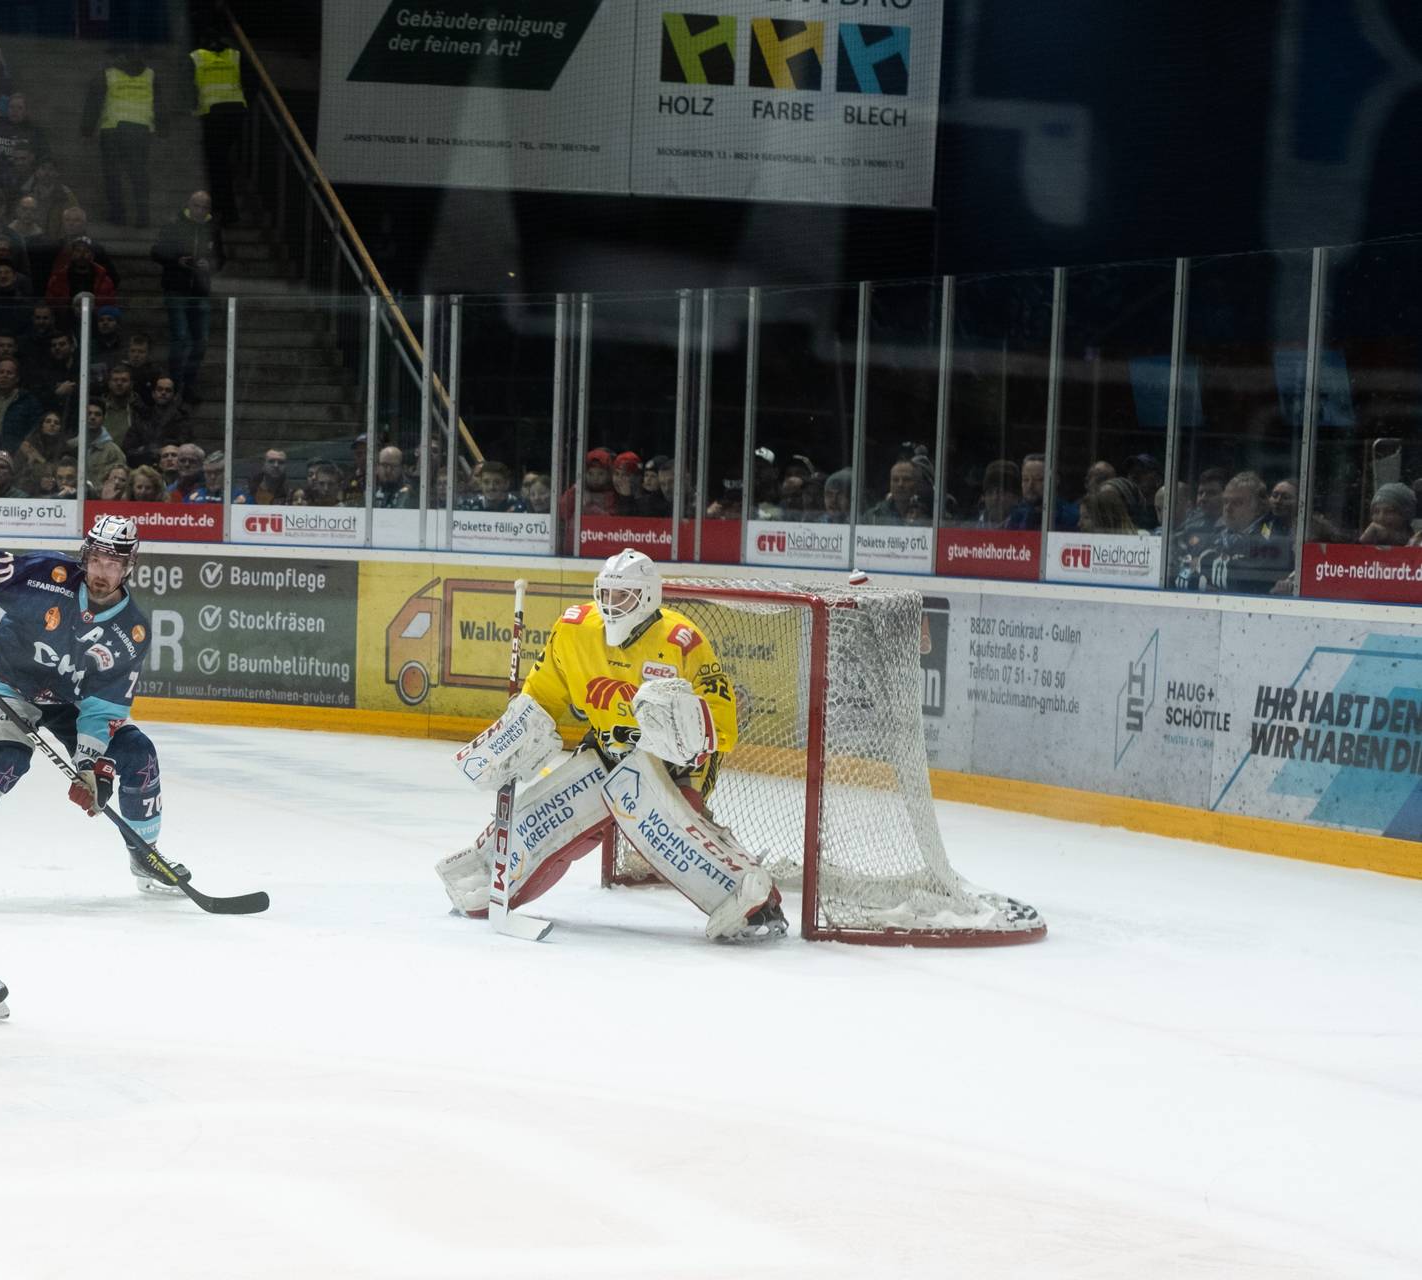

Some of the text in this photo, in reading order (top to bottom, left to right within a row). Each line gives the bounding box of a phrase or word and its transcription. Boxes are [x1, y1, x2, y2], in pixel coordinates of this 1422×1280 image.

[395, 8, 568, 40] Gebäudereinigung
[387, 33, 521, 57] der feinen Art!
[658, 95, 907, 127] HOLZ FARBE BLECH
[36, 504, 67, 518] GTÜ.
[245, 514, 357, 533] GTÜ Neidhardt
[453, 520, 550, 537] Plakette fällig? GTÜ.
[580, 529, 673, 546] gtue-neidhardt.de
[757, 531, 843, 553] GTÜ Neidhardt
[856, 535, 928, 553] Plakette fällig? GTÜ.
[947, 543, 1032, 563] gtue-neidhardt.de
[1061, 544, 1151, 569] GTÜ Neidhardt
[229, 565, 326, 592] Baumpflege
[77, 625, 105, 643] A
[228, 609, 326, 634] Stockfräsen
[459, 620, 512, 643] Walko
[970, 616, 1082, 644] 88287 Grünkraut Gullen
[969, 639, 1039, 663] Kaufstraße 6 8
[227, 652, 350, 684] Baumbelüftung
[968, 661, 1066, 689] Telefon 07 51 7 60 50
[966, 686, 1080, 715] www.buchmann-gmbh.de
[1253, 685, 1422, 736] IHR HABT DEN
[1165, 703, 1231, 732] SCHÖTTLE
[456, 719, 505, 762] CCM
[493, 728, 524, 757] KREFELD
[1250, 721, 1300, 760] WIR
[1300, 726, 1390, 771] HABEN
[477, 758, 490, 769] KR
[516, 766, 606, 838] WOHNSTÄTTE
[620, 791, 637, 815] KR
[475, 823, 497, 849] CC
[494, 793, 513, 892] CCM
[523, 806, 575, 852] KREFELD
[637, 820, 690, 873] KREFELD
[647, 808, 737, 892] WOHNSTÄTTE
[685, 824, 744, 872] CCM
